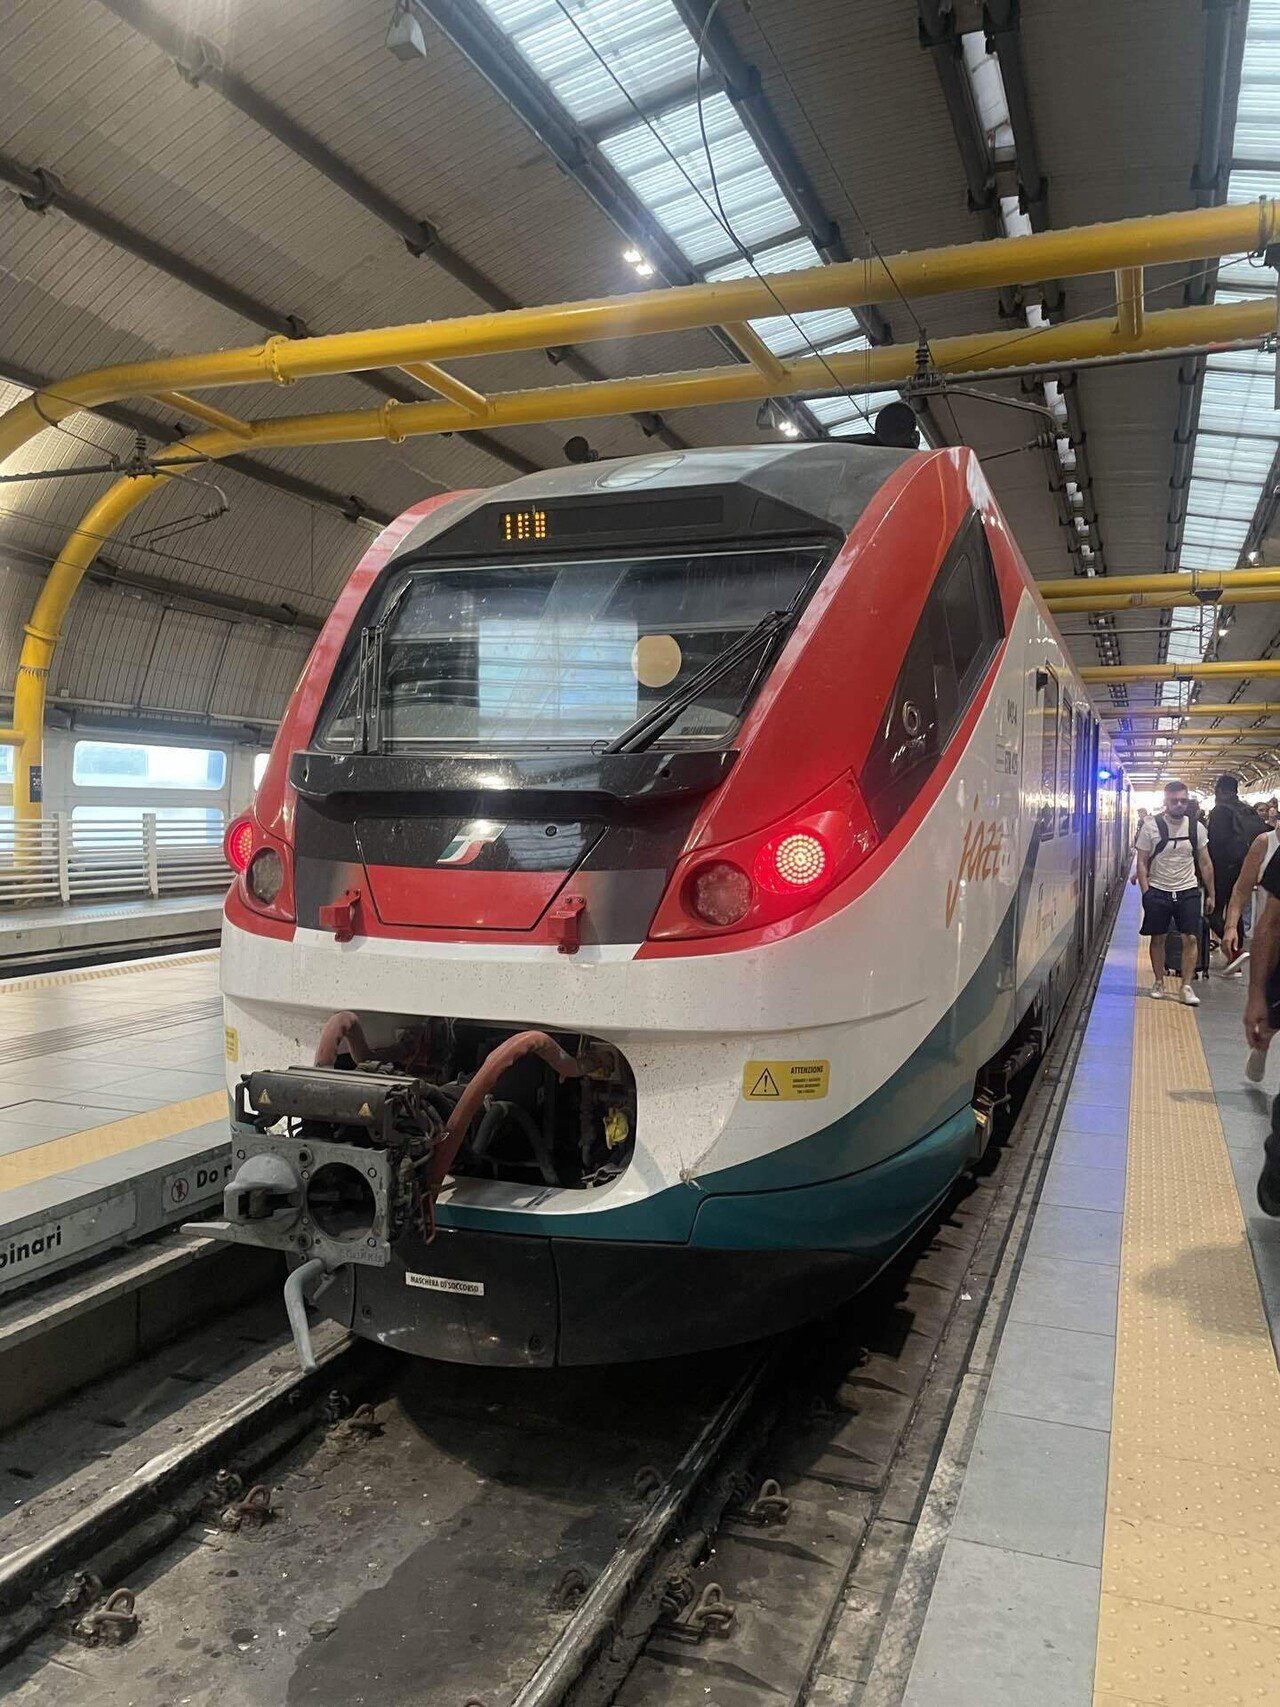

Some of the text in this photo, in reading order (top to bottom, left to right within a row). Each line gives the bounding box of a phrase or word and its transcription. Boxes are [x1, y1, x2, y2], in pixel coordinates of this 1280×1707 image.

[790, 1065, 824, 1075] ATTENZIONE
[196, 1169, 219, 1189] Do
[410, 1276, 439, 1287] MASCHERA
[447, 1282, 479, 1293] SOCCORSO
